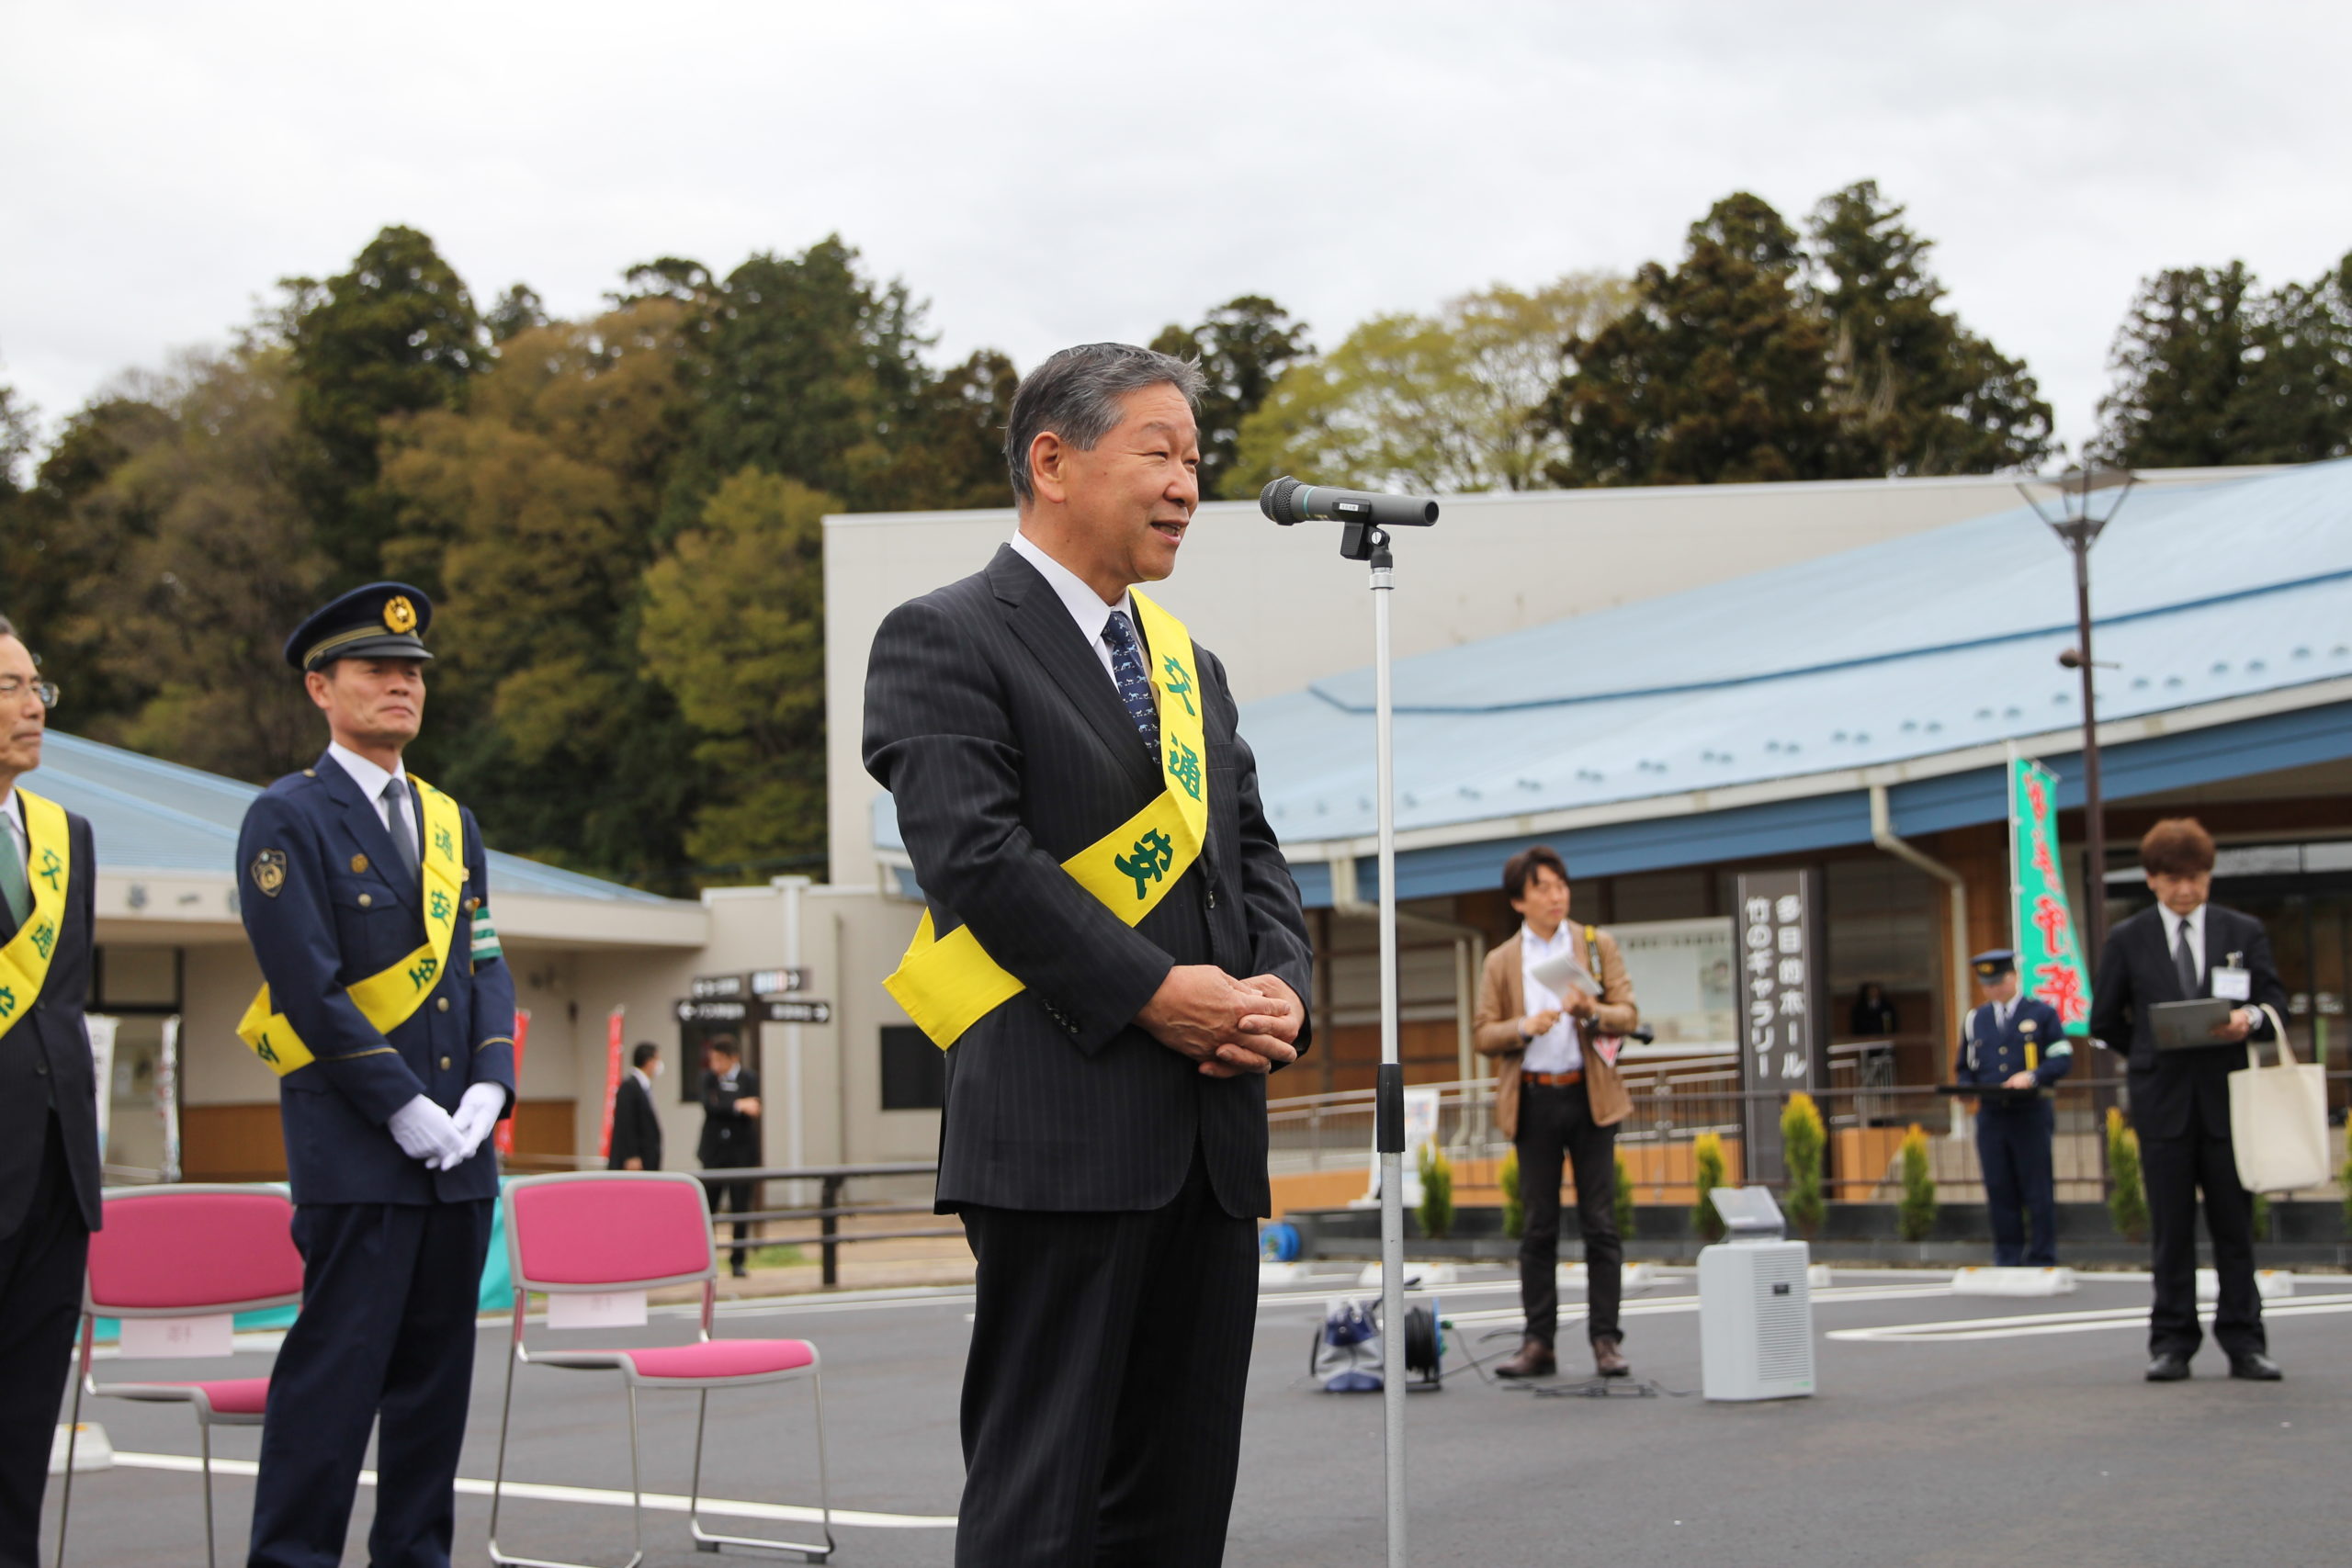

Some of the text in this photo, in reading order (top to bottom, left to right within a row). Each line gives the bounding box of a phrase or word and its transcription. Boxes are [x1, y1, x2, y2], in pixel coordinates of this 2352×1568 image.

[1746, 896, 1775, 1079] 竹のギャラリー
[1775, 895, 1806, 1079] 多目的ホール
